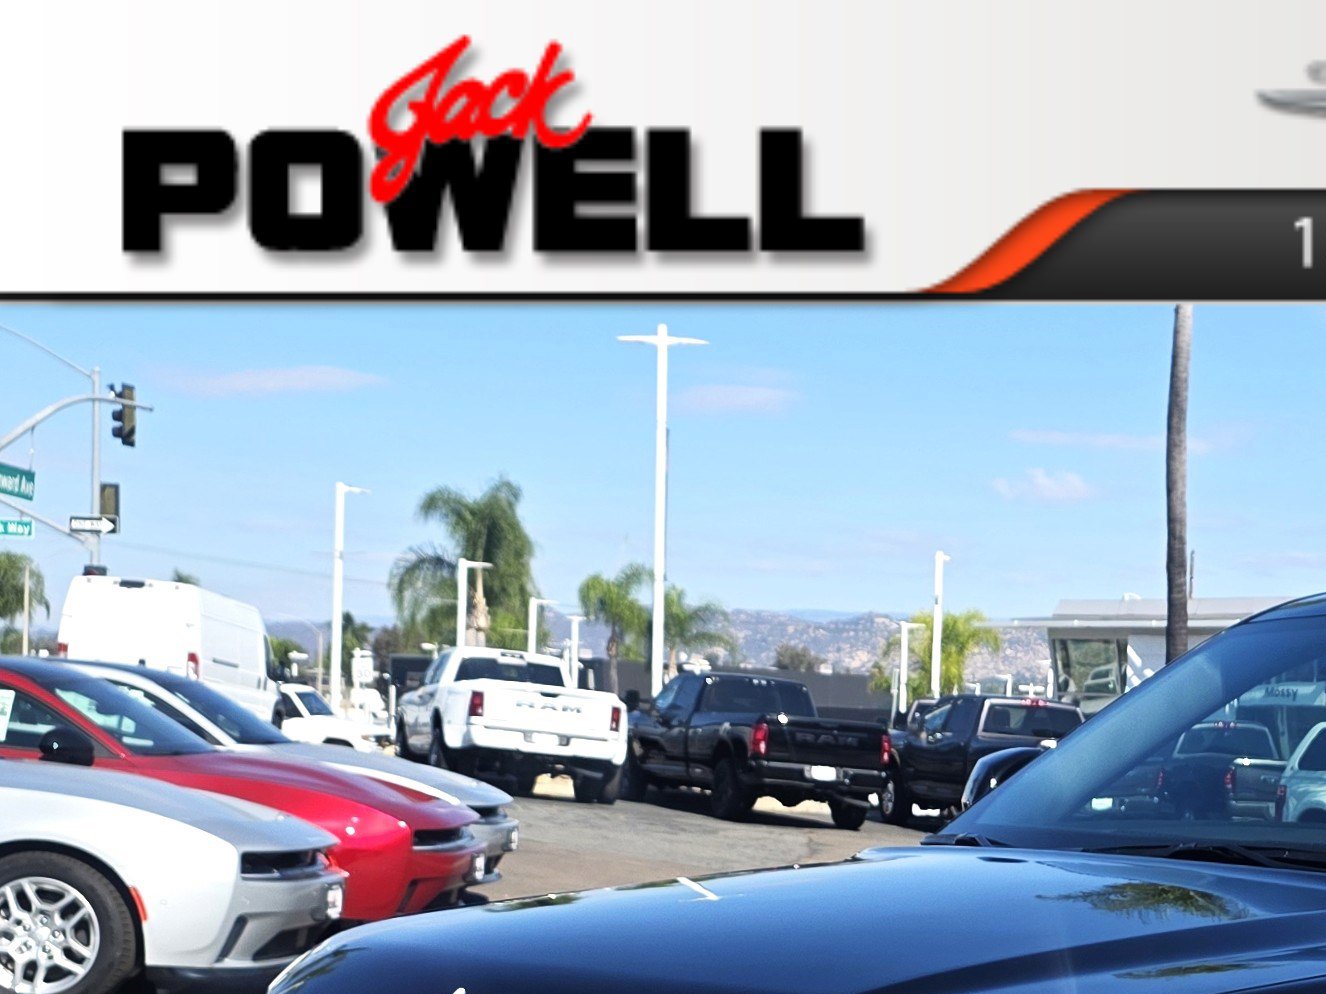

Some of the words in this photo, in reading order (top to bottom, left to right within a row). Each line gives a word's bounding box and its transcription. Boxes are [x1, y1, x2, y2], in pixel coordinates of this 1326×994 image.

[1264, 686, 1299, 701] Mossy
[515, 699, 582, 714] RAM
[795, 731, 860, 748] RAM
